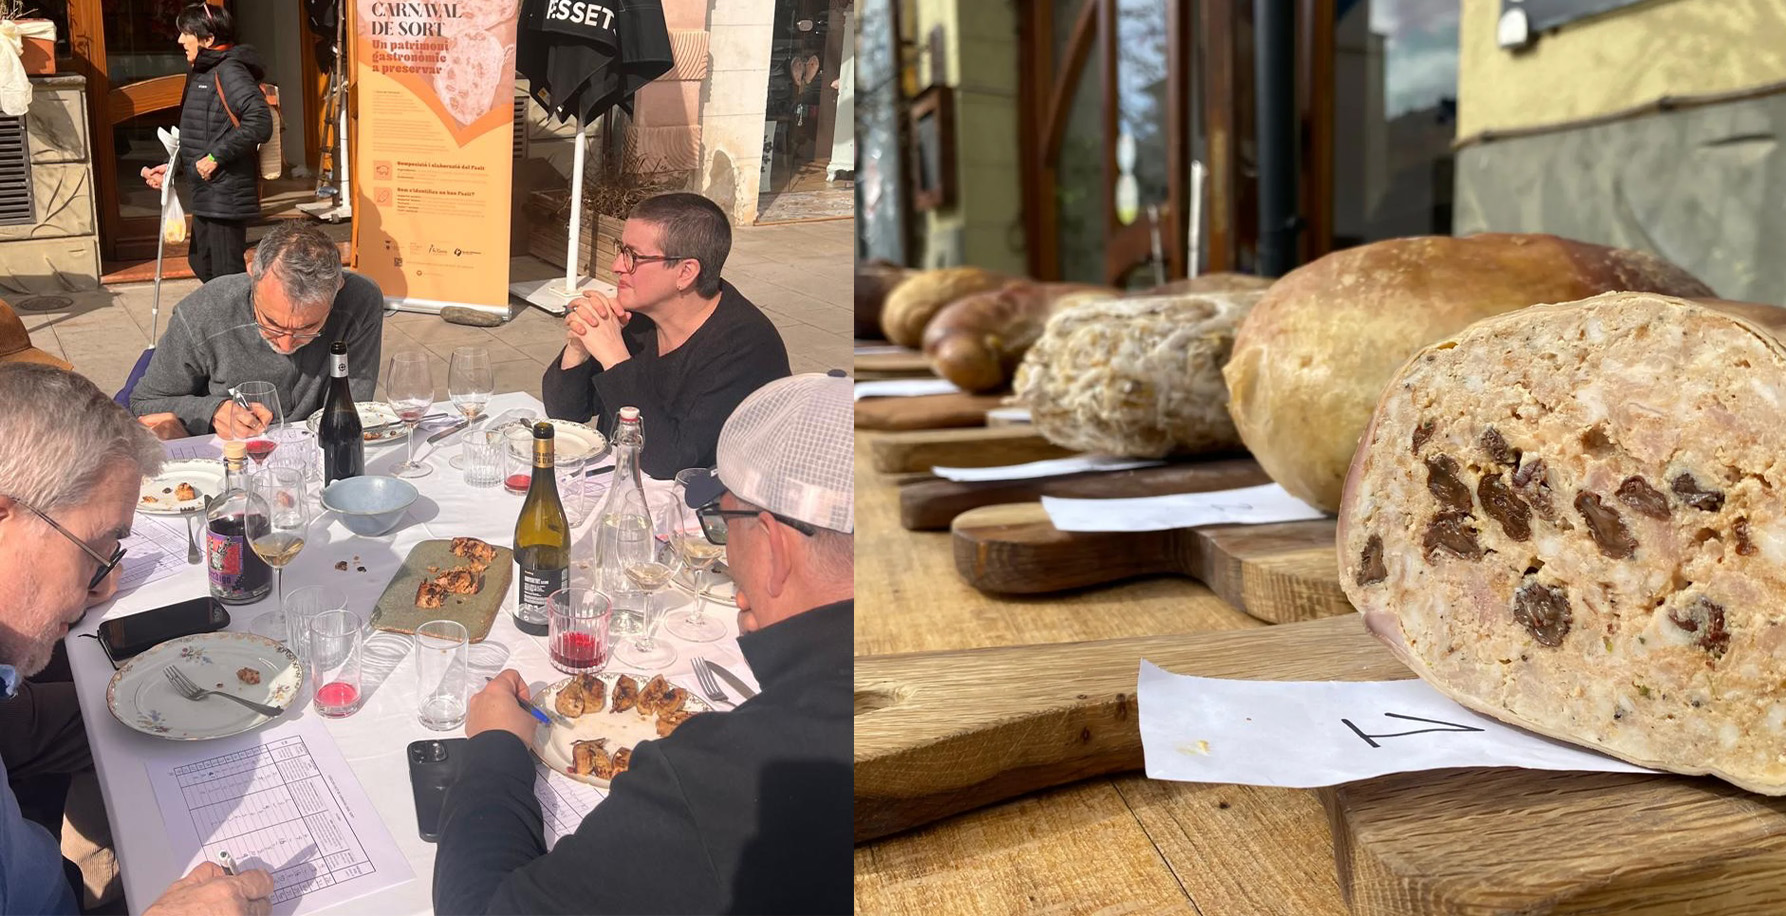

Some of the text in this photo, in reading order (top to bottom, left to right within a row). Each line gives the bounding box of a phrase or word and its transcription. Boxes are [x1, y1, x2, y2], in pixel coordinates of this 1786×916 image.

[371, 2, 462, 18] CARNAVAL
[371, 21, 445, 37] DE SORT
[372, 39, 449, 52] Un patrimoni
[382, 65, 442, 75] preservar
